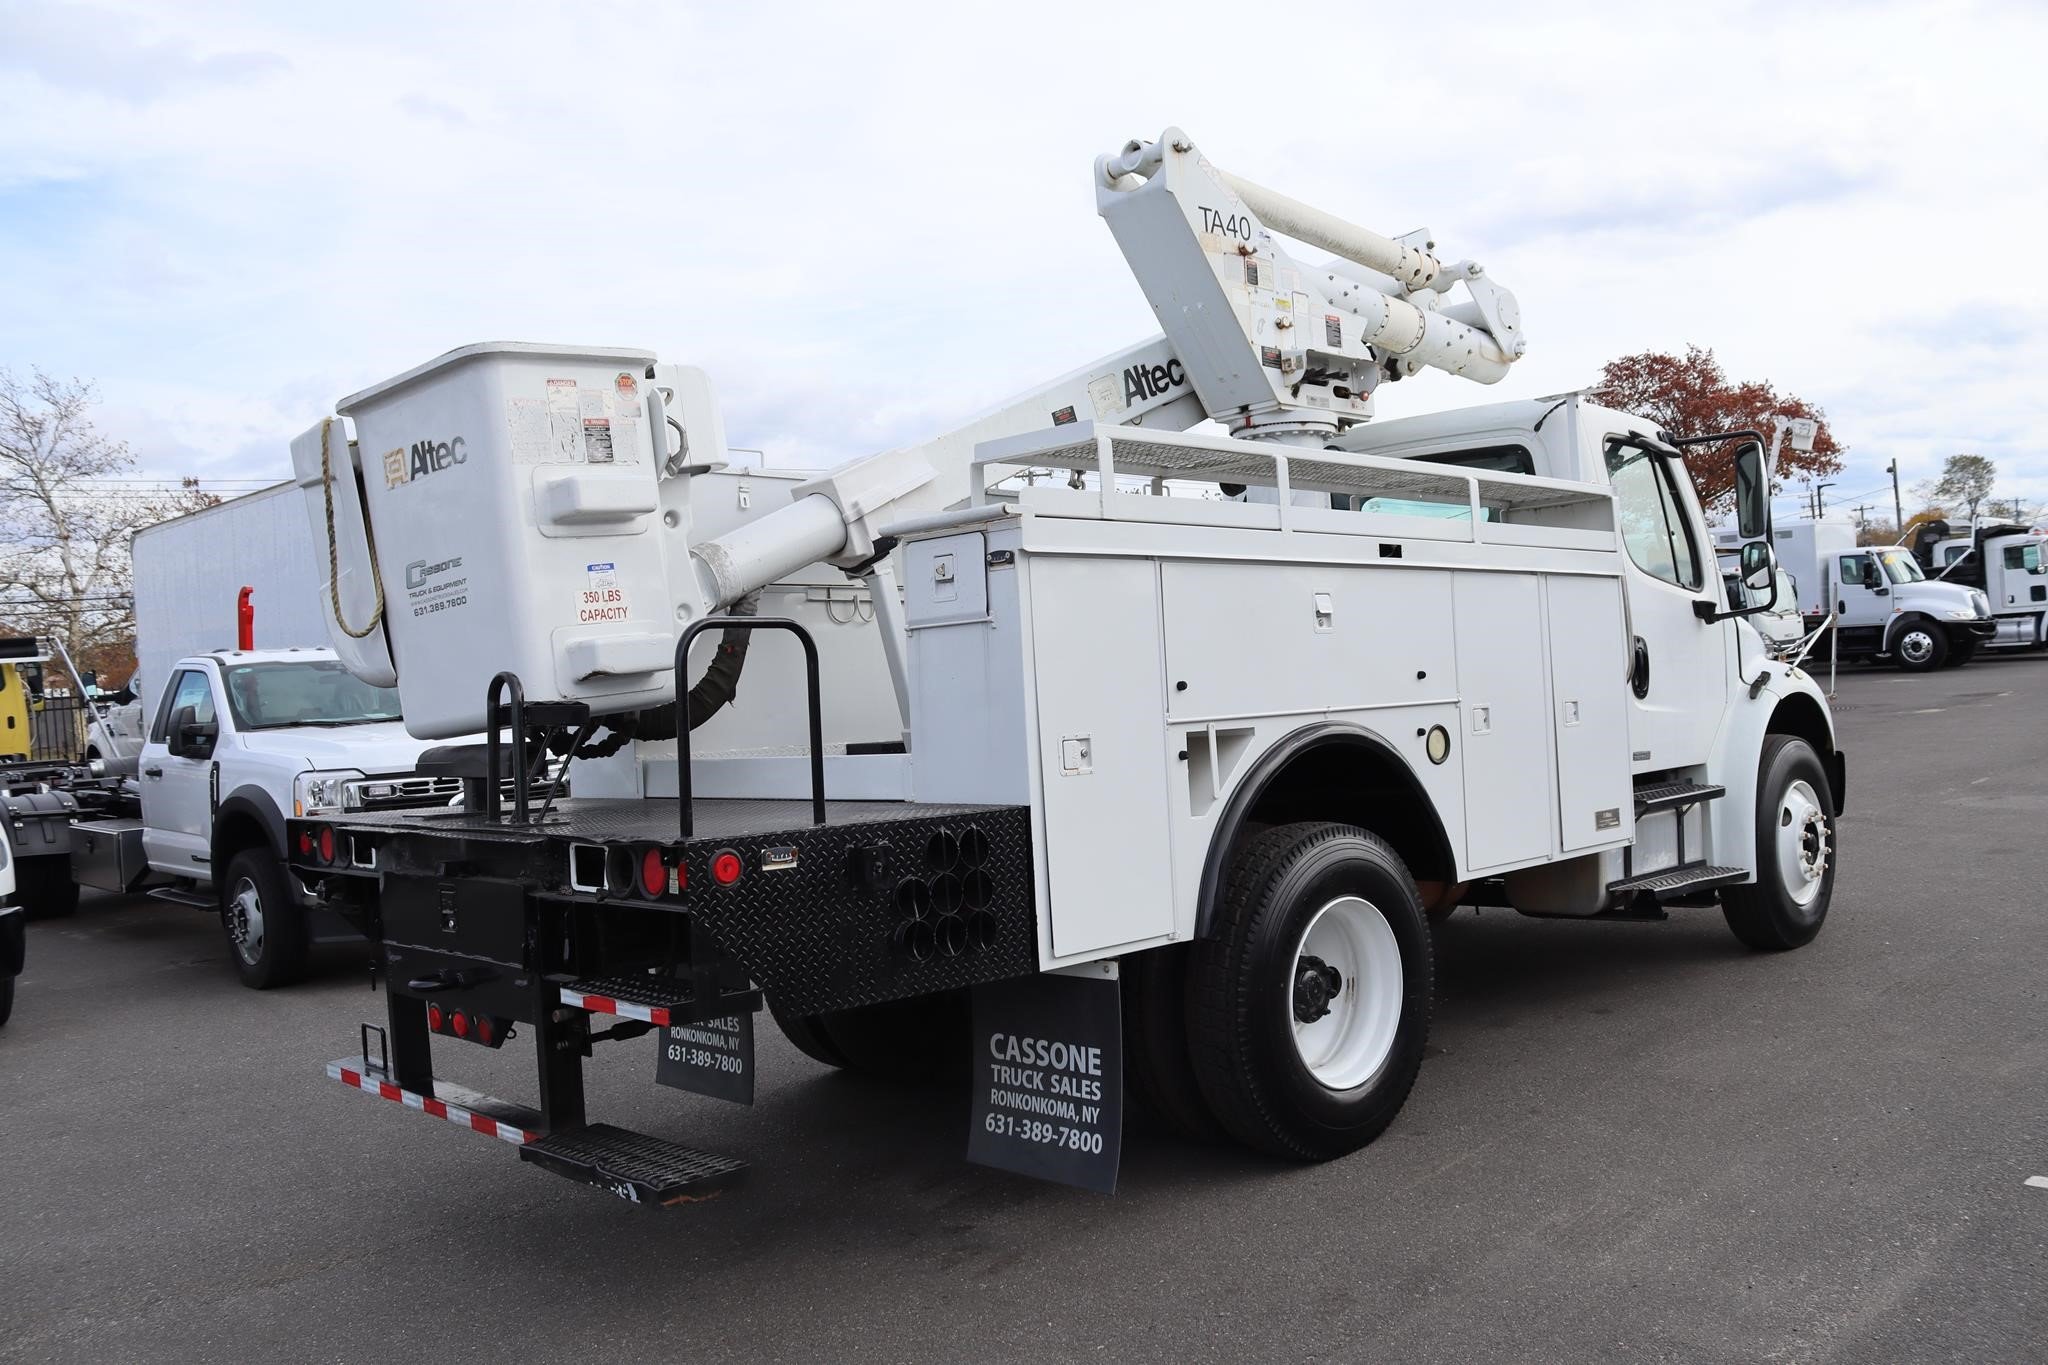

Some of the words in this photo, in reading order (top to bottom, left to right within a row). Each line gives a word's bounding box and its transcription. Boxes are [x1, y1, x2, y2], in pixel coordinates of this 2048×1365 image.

[1198, 206, 1251, 241] TA40
[1123, 358, 1185, 408] Altec
[410, 436, 468, 482] Altec
[408, 589, 428, 599] TRUCK
[433, 577, 467, 593] EQUIPMENT
[583, 591, 600, 604] 350
[601, 589, 622, 603] LBS
[413, 595, 468, 617] 631.389.7800
[580, 606, 628, 622] CAPACITY
[670, 1026, 728, 1050] RONKONKOMA,
[728, 1036, 740, 1051] NY
[990, 1032, 1102, 1077] CASSONE
[668, 1044, 743, 1075] 631-389-7800
[990, 1064, 1045, 1091] TRUCK
[1050, 1074, 1102, 1101] SALES
[990, 1088, 1080, 1124] RONKONKOMA,
[1082, 1105, 1100, 1125] NY
[985, 1112, 1103, 1155] 631-389-7800
